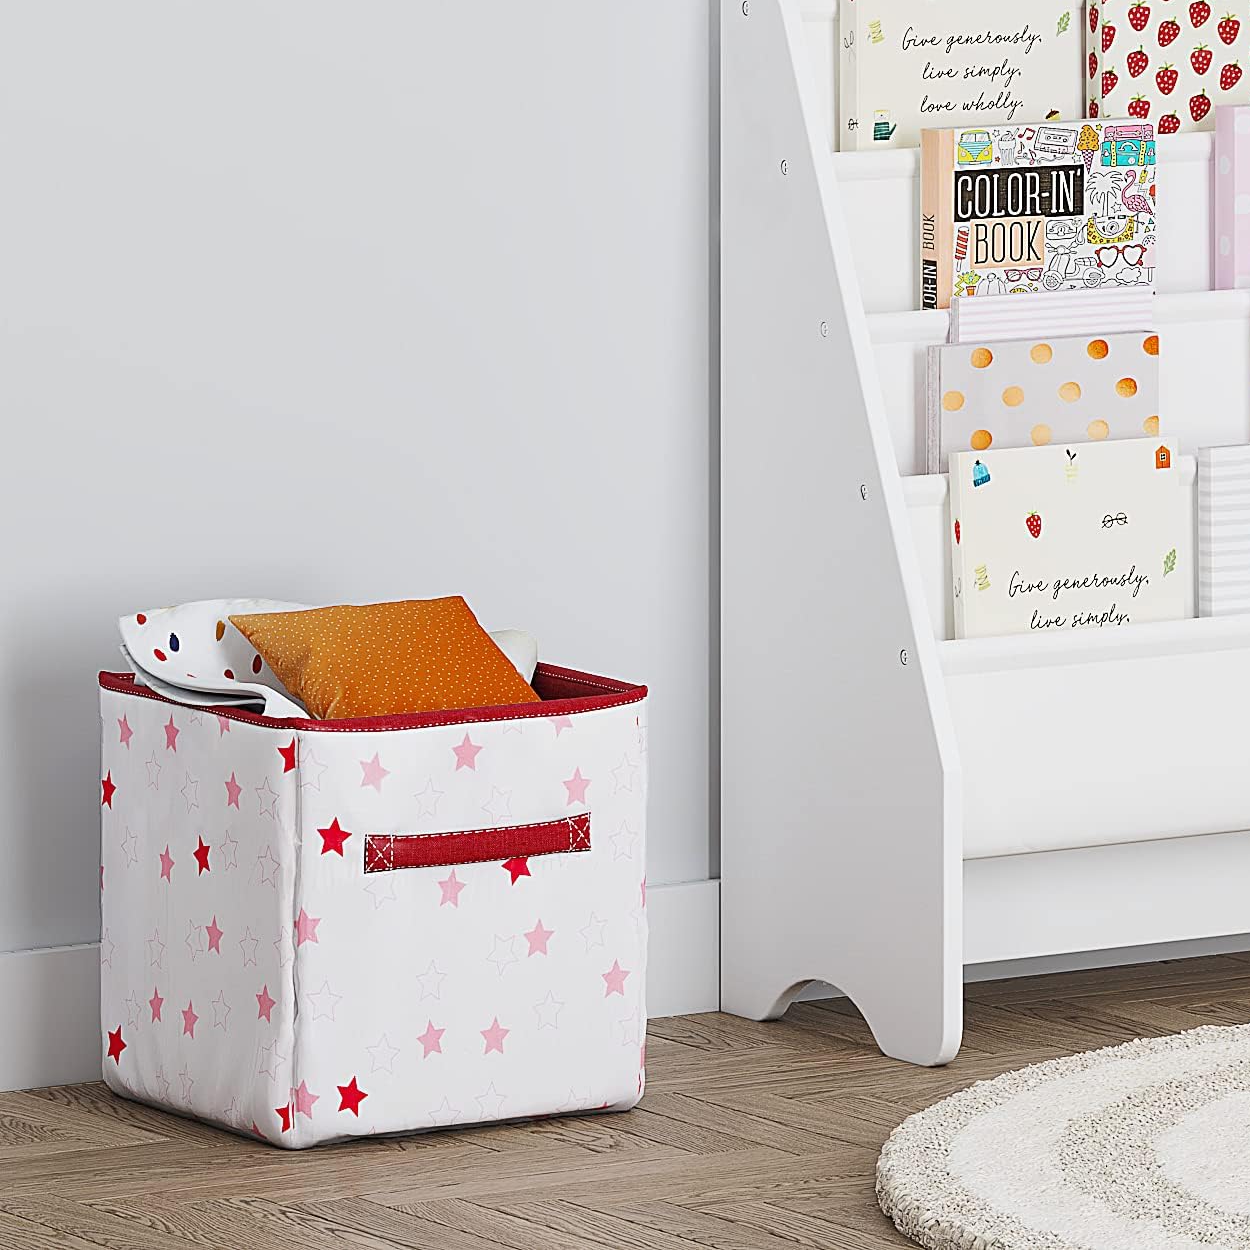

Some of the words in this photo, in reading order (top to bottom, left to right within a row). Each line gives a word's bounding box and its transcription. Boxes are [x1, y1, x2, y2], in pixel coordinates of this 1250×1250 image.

[902, 26, 943, 51] Give
[922, 61, 959, 80] live
[920, 94, 957, 113] love
[962, 91, 1024, 121] wholly.
[922, 213, 935, 250] BOOK
[974, 220, 1042, 264] BOOK
[1008, 570, 1049, 598] Give
[1030, 609, 1067, 630] live
